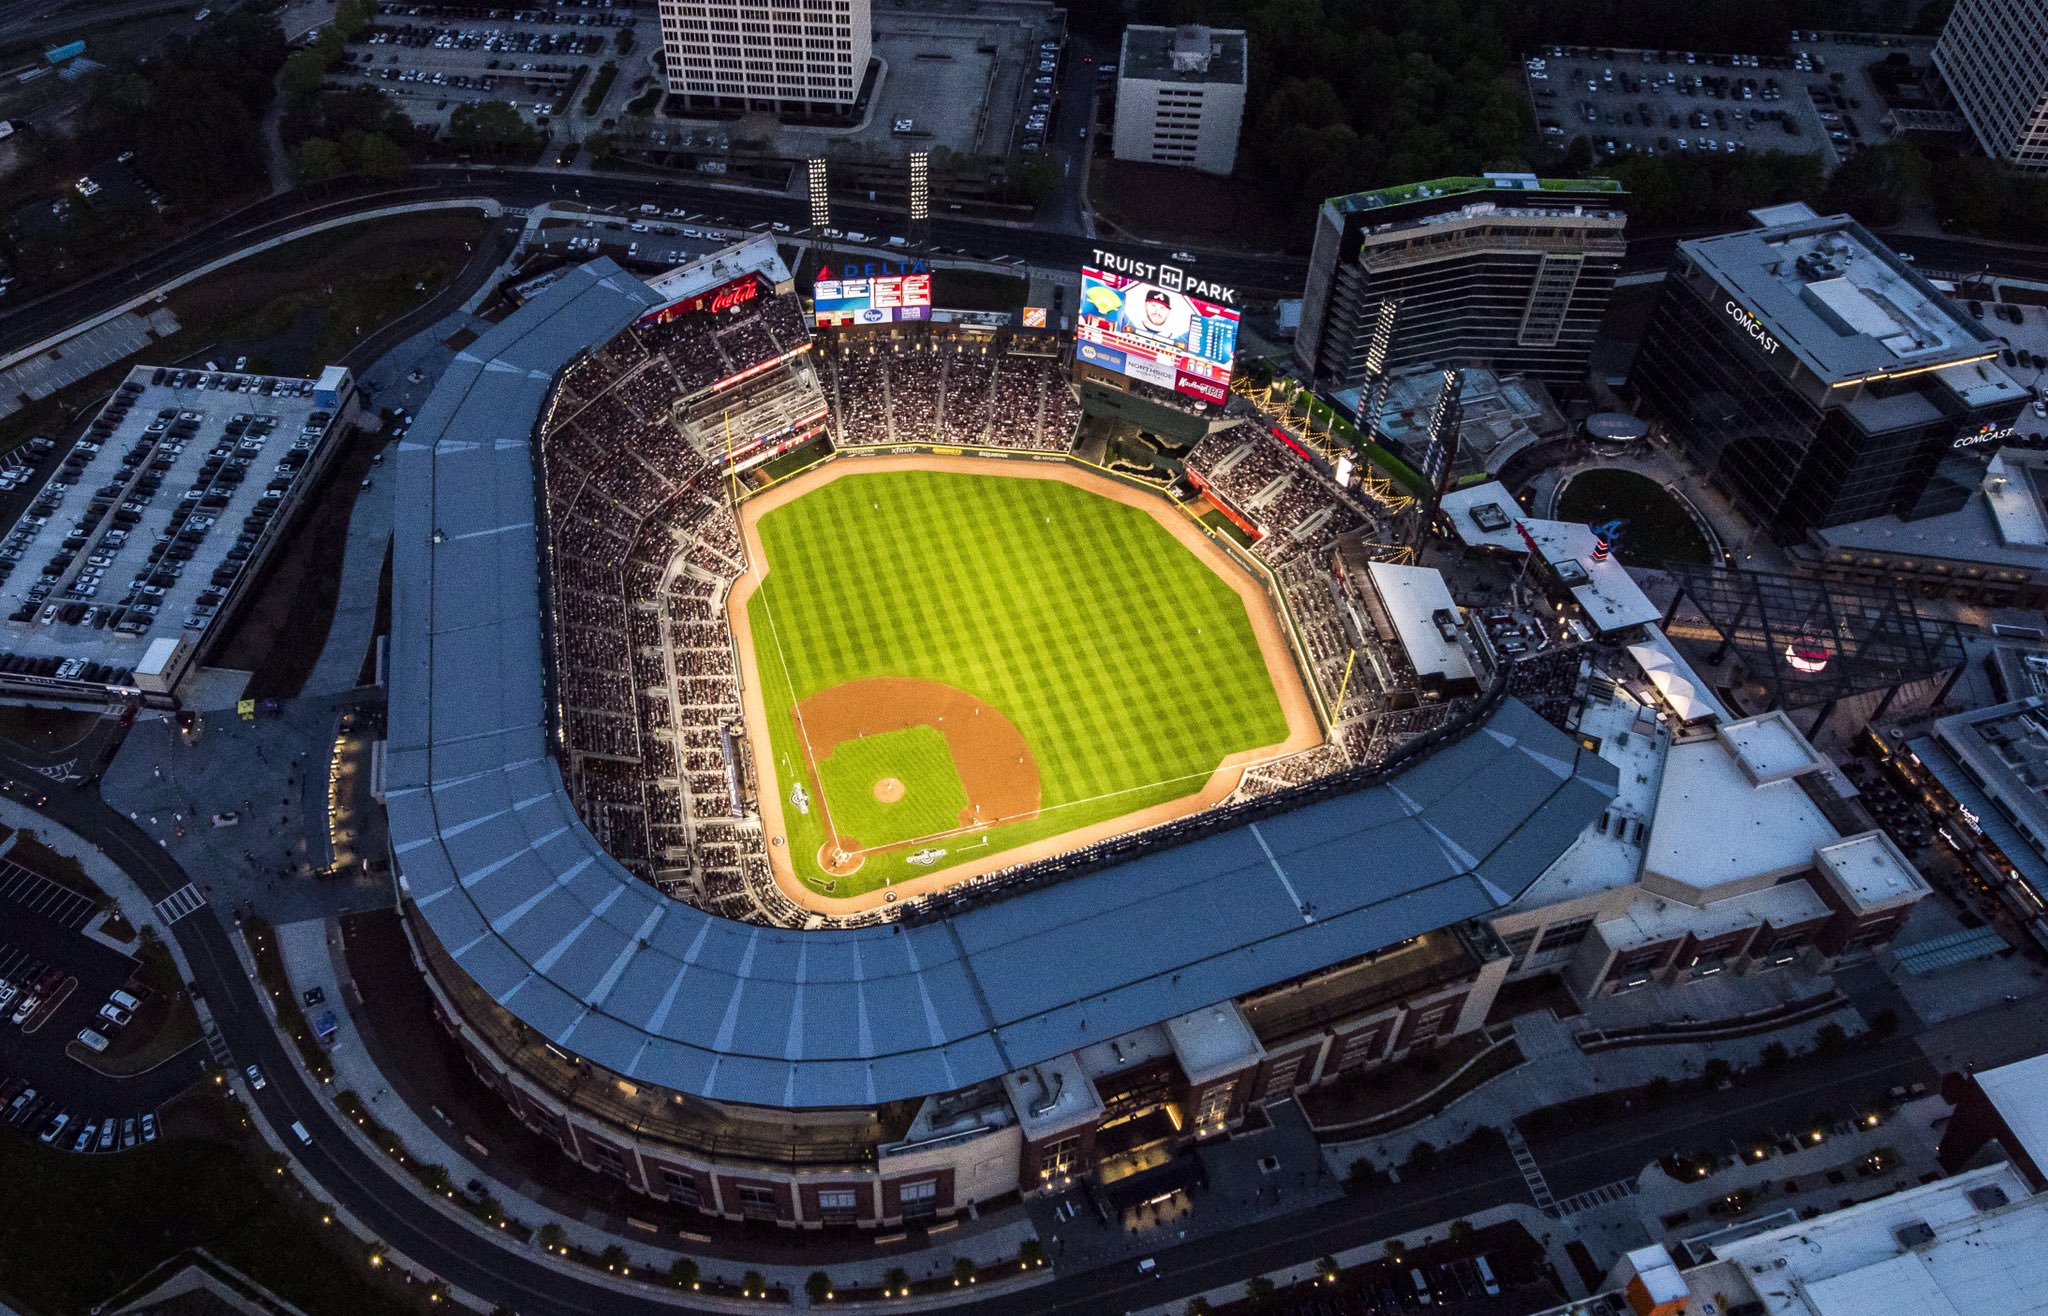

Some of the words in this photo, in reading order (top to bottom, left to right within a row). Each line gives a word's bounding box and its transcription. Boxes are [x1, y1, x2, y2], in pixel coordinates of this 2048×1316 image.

[843, 260, 927, 278] DELTA
[1093, 249, 1156, 280] TRUIST
[1186, 277, 1235, 304] PARK
[1725, 301, 1780, 354] COMCAST
[1127, 361, 1174, 380] NORTHSIDE
[1953, 427, 2014, 448] COMCAST
[891, 446, 917, 455] xfinity
